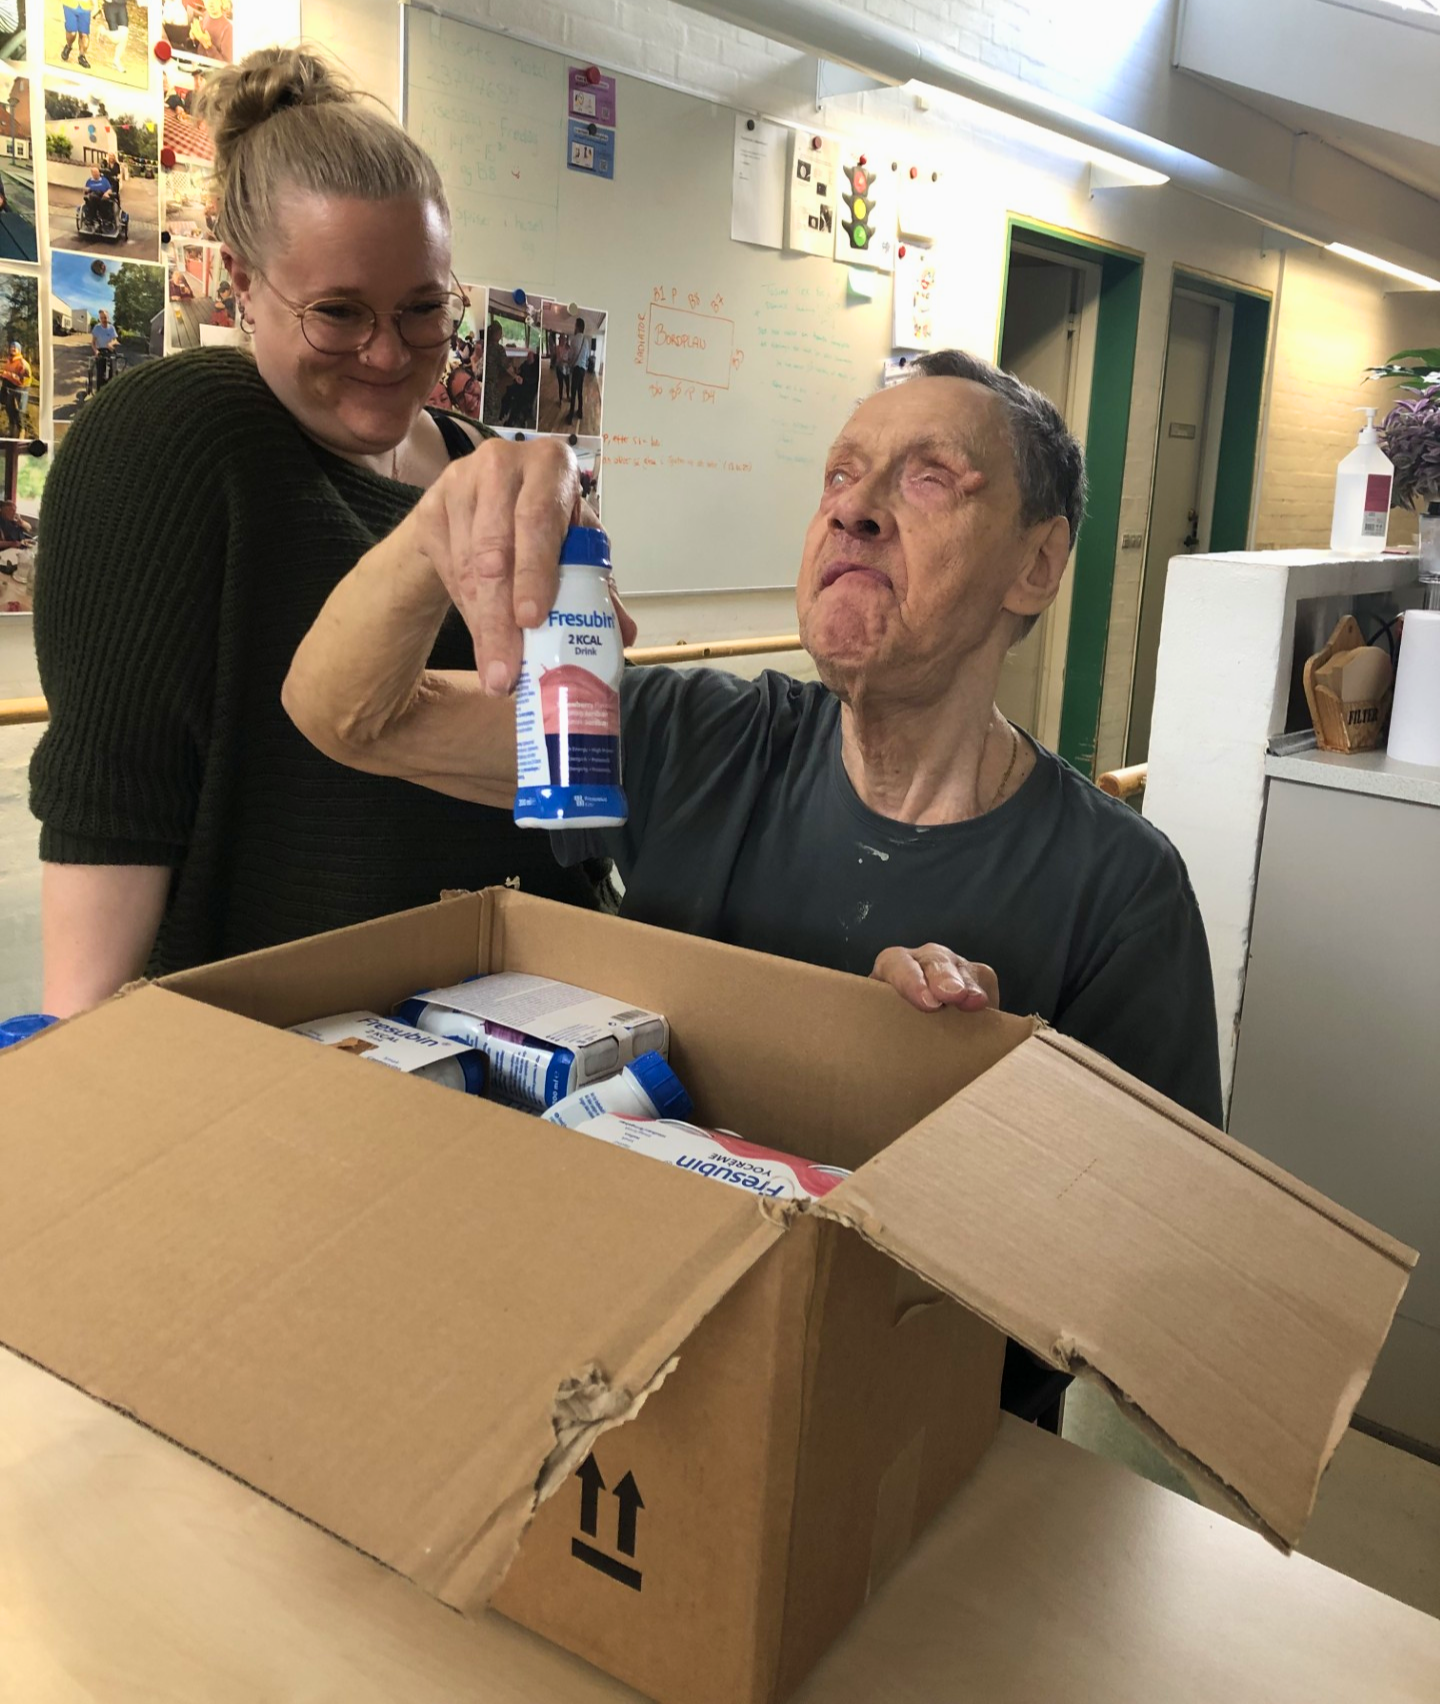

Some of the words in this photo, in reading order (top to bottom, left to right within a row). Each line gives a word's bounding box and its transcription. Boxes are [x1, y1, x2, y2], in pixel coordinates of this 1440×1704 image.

[672, 287, 677, 304] P
[635, 312, 646, 365] RADIATOR
[548, 610, 615, 629] Fresubin
[568, 634, 575, 645] 2
[576, 635, 603, 646] KCAL
[575, 647, 597, 656] Drink
[1348, 708, 1378, 725] FILTER
[357, 1018, 438, 1047] Fresubin
[373, 1031, 399, 1043] KCAL
[676, 1155, 785, 1198] Fresubin
